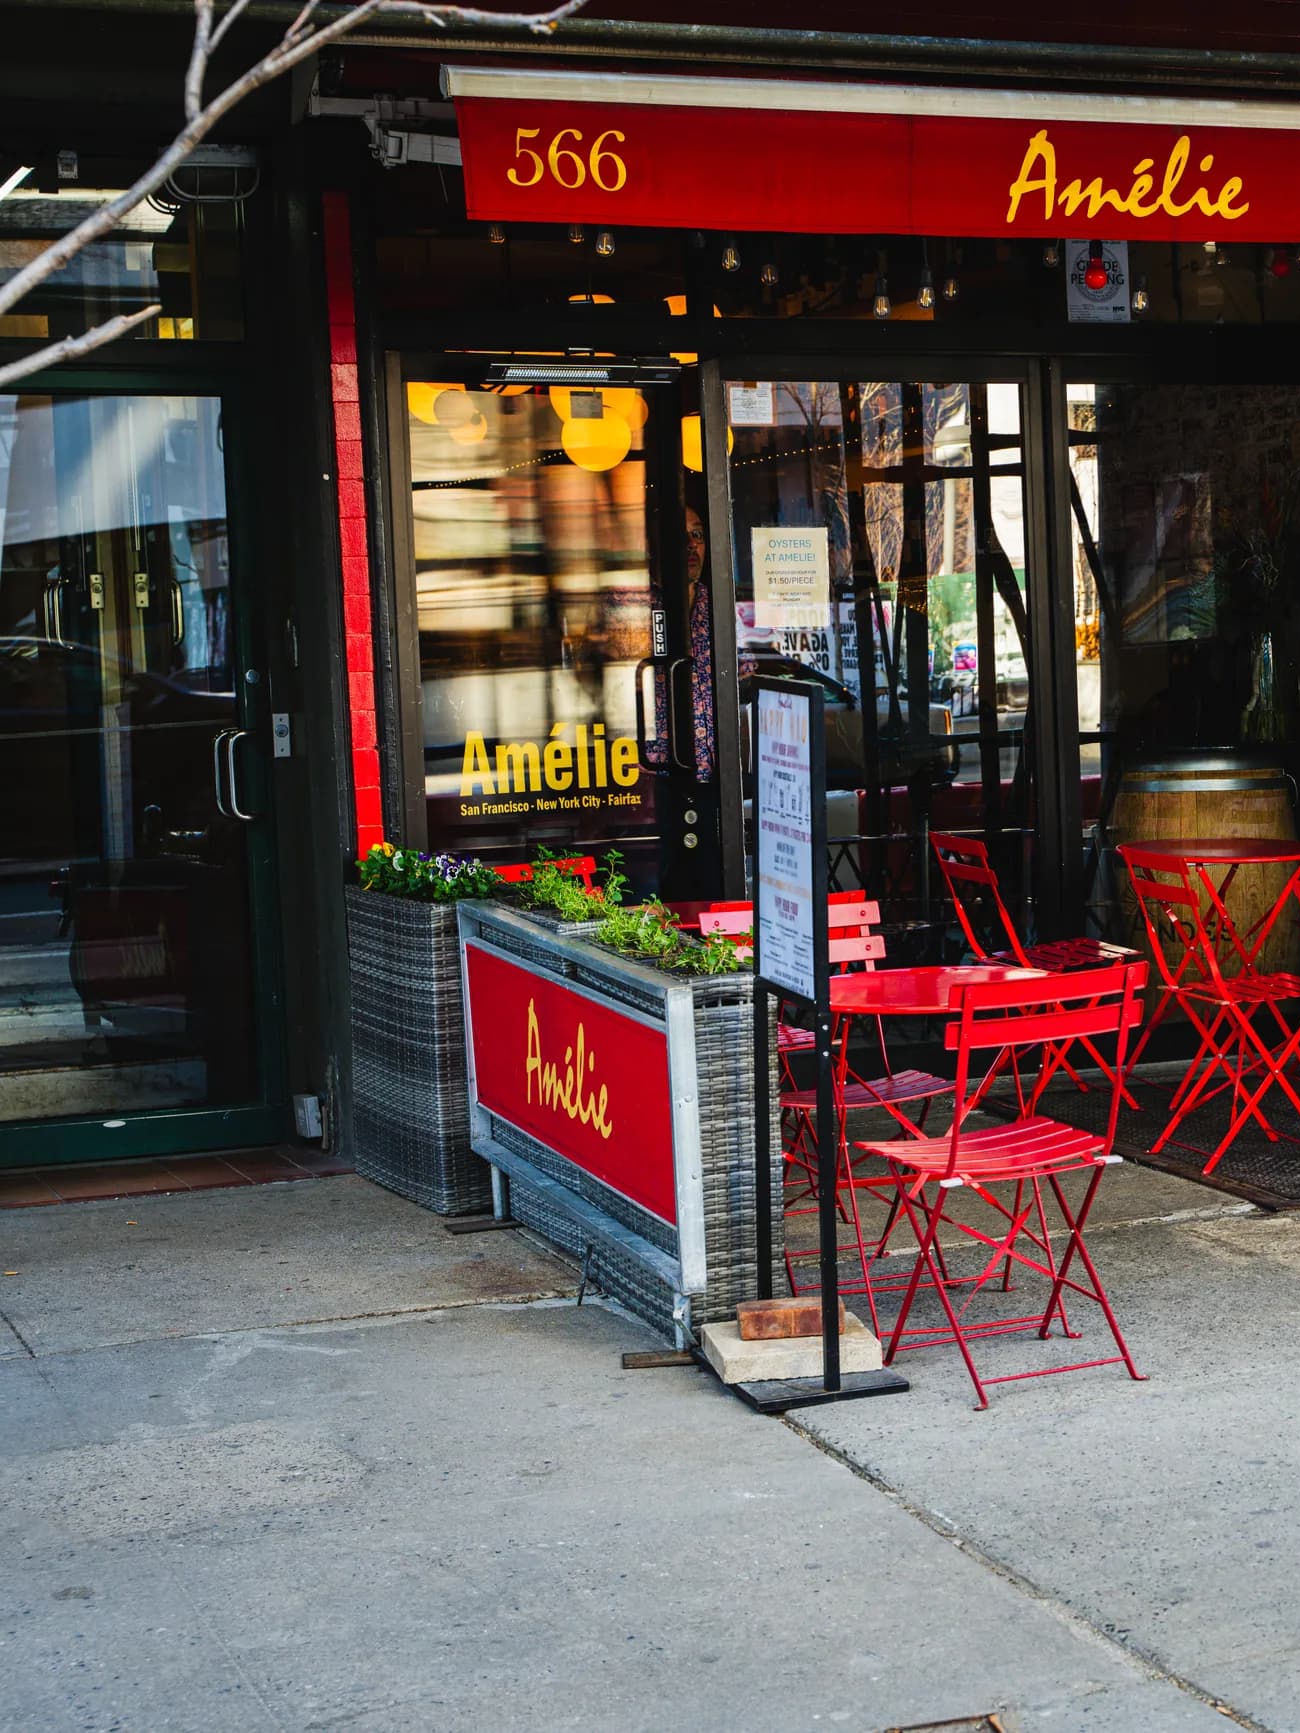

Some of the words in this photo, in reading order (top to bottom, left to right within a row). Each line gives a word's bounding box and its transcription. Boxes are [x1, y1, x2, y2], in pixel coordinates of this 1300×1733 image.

[507, 127, 627, 192] 566
[1006, 129, 1250, 224] Amélie
[1076, 260, 1119, 272] GDE
[764, 553, 777, 562] AT
[768, 539, 812, 549] OYSTERS
[767, 576, 815, 585] $1.50/PIECE
[655, 613, 665, 653] PUSH
[459, 722, 640, 797] Amélie
[460, 804, 480, 816] San
[482, 800, 530, 815] Francisco
[536, 798, 557, 812] New
[558, 796, 580, 809] York
[582, 794, 601, 809] City
[608, 793, 641, 806] Fairfax
[526, 997, 614, 1140] Amélie
